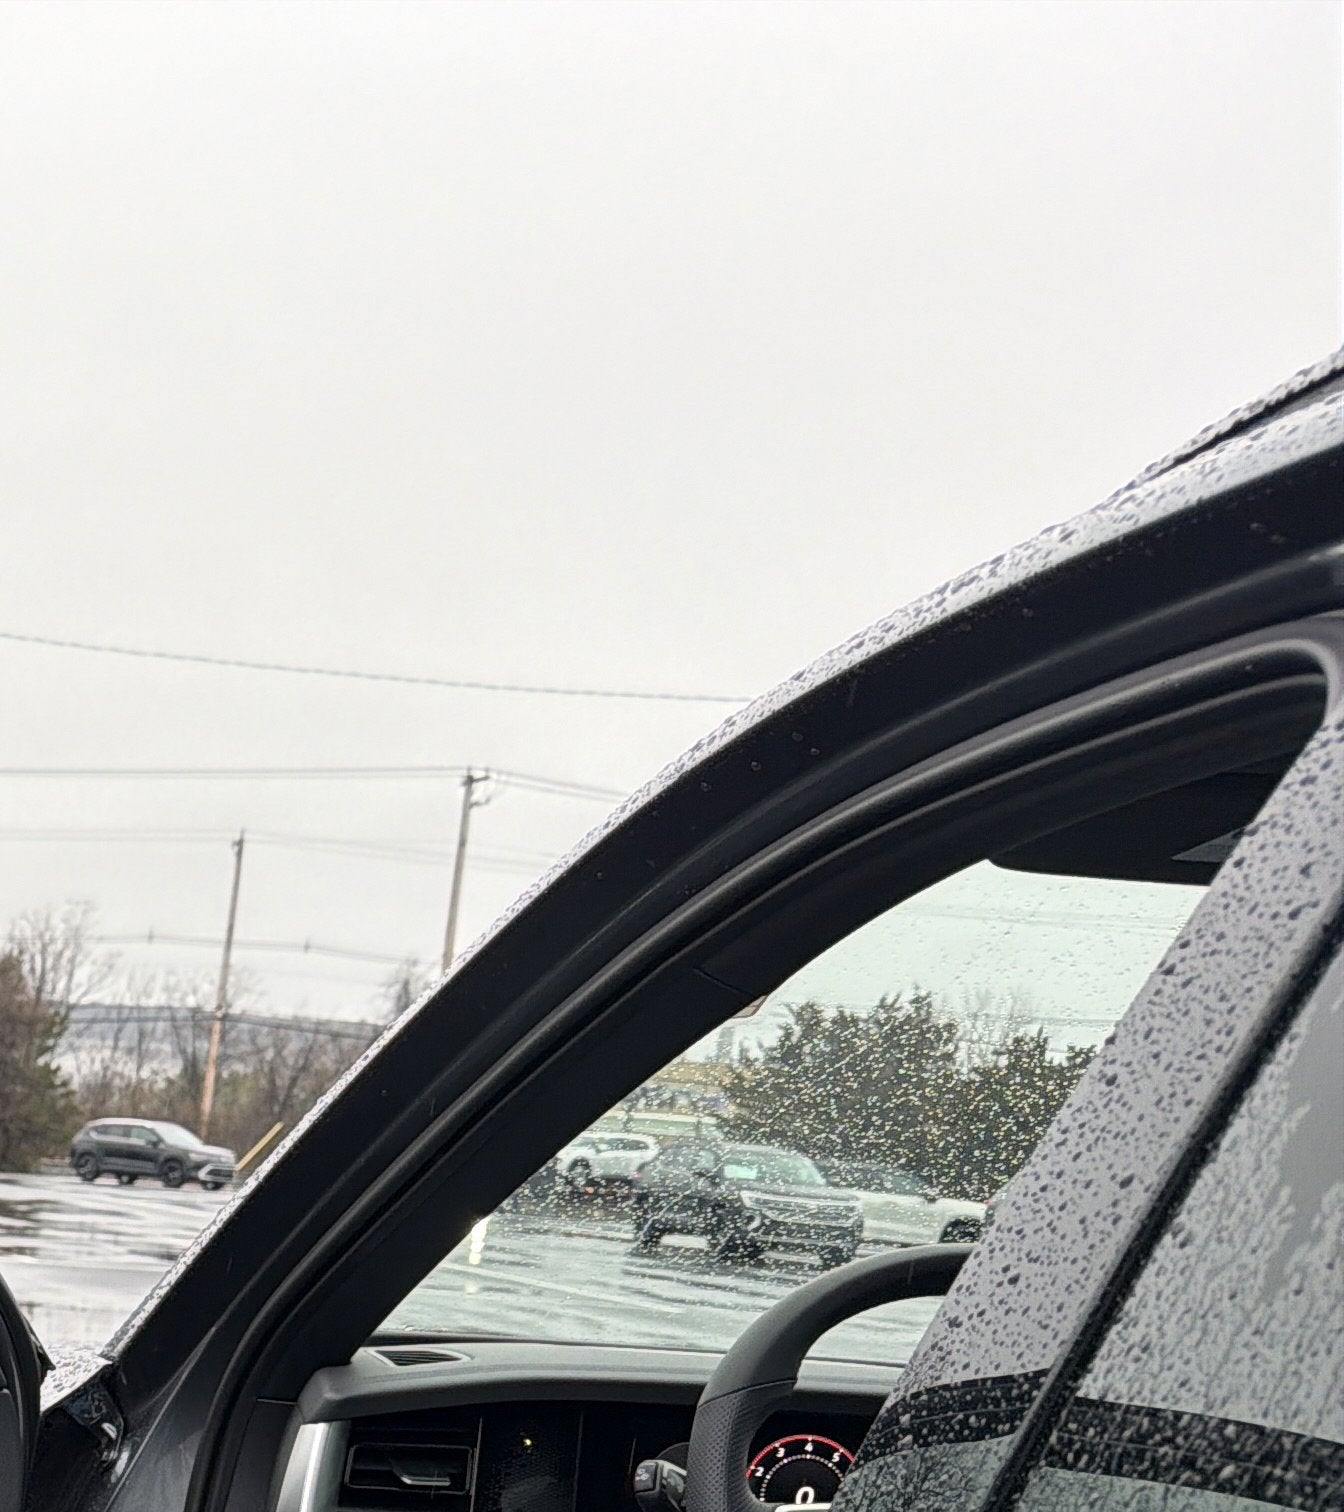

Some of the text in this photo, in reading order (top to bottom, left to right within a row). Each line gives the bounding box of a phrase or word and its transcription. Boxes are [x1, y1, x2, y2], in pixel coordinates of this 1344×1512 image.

[804, 1443, 813, 1452] 4
[776, 1448, 785, 1457] 3
[832, 1453, 841, 1462] 5
[755, 1467, 764, 1477] 2
